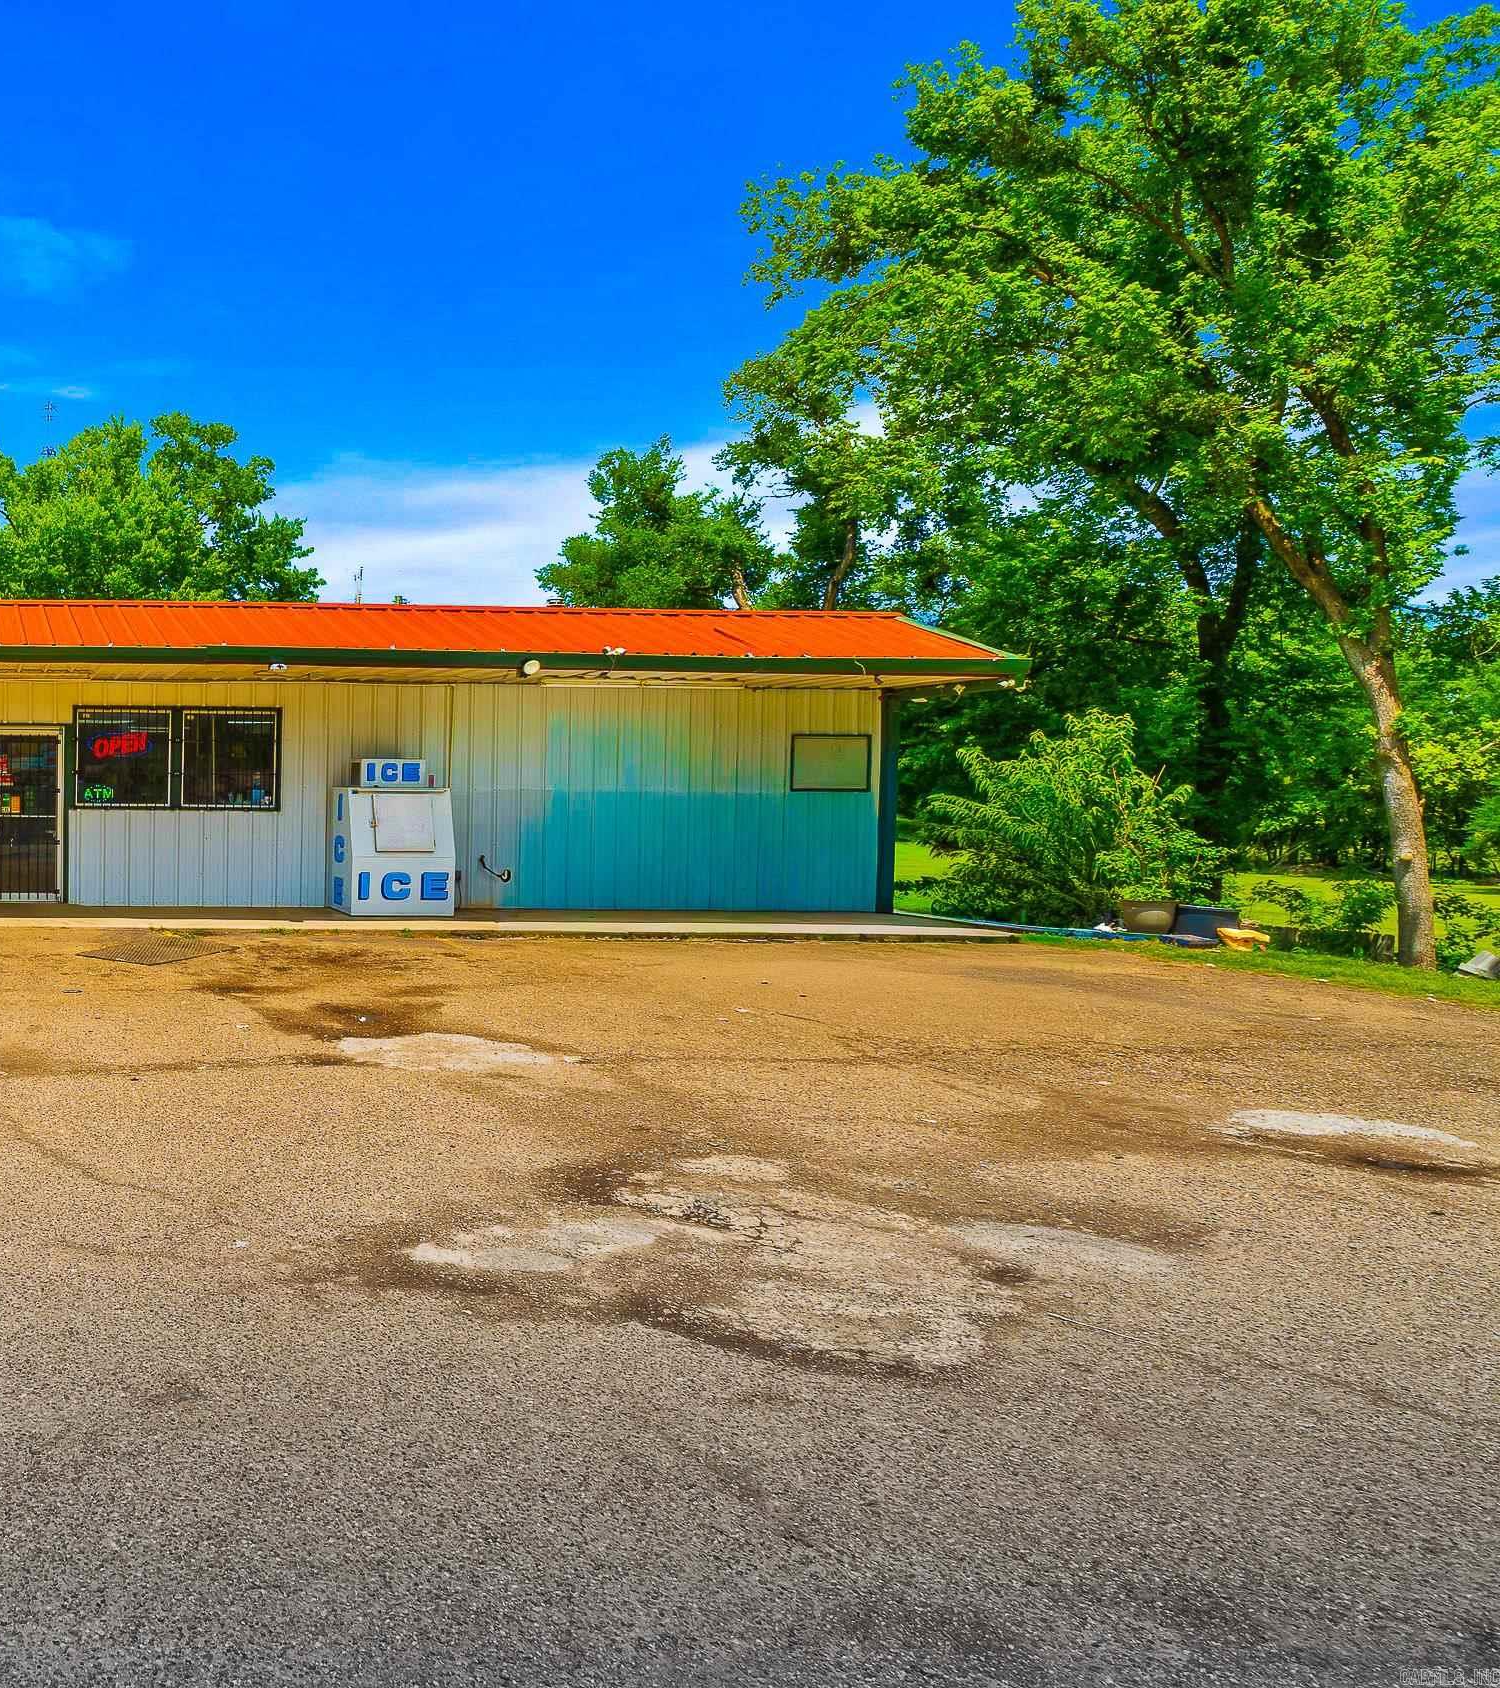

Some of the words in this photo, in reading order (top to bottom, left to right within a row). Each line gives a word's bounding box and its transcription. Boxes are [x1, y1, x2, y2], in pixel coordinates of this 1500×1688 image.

[92, 731, 148, 760] OPEN
[366, 762, 421, 782] ICE
[84, 788, 114, 799] ATM
[333, 792, 346, 906] ICE
[357, 871, 450, 901] ICE
